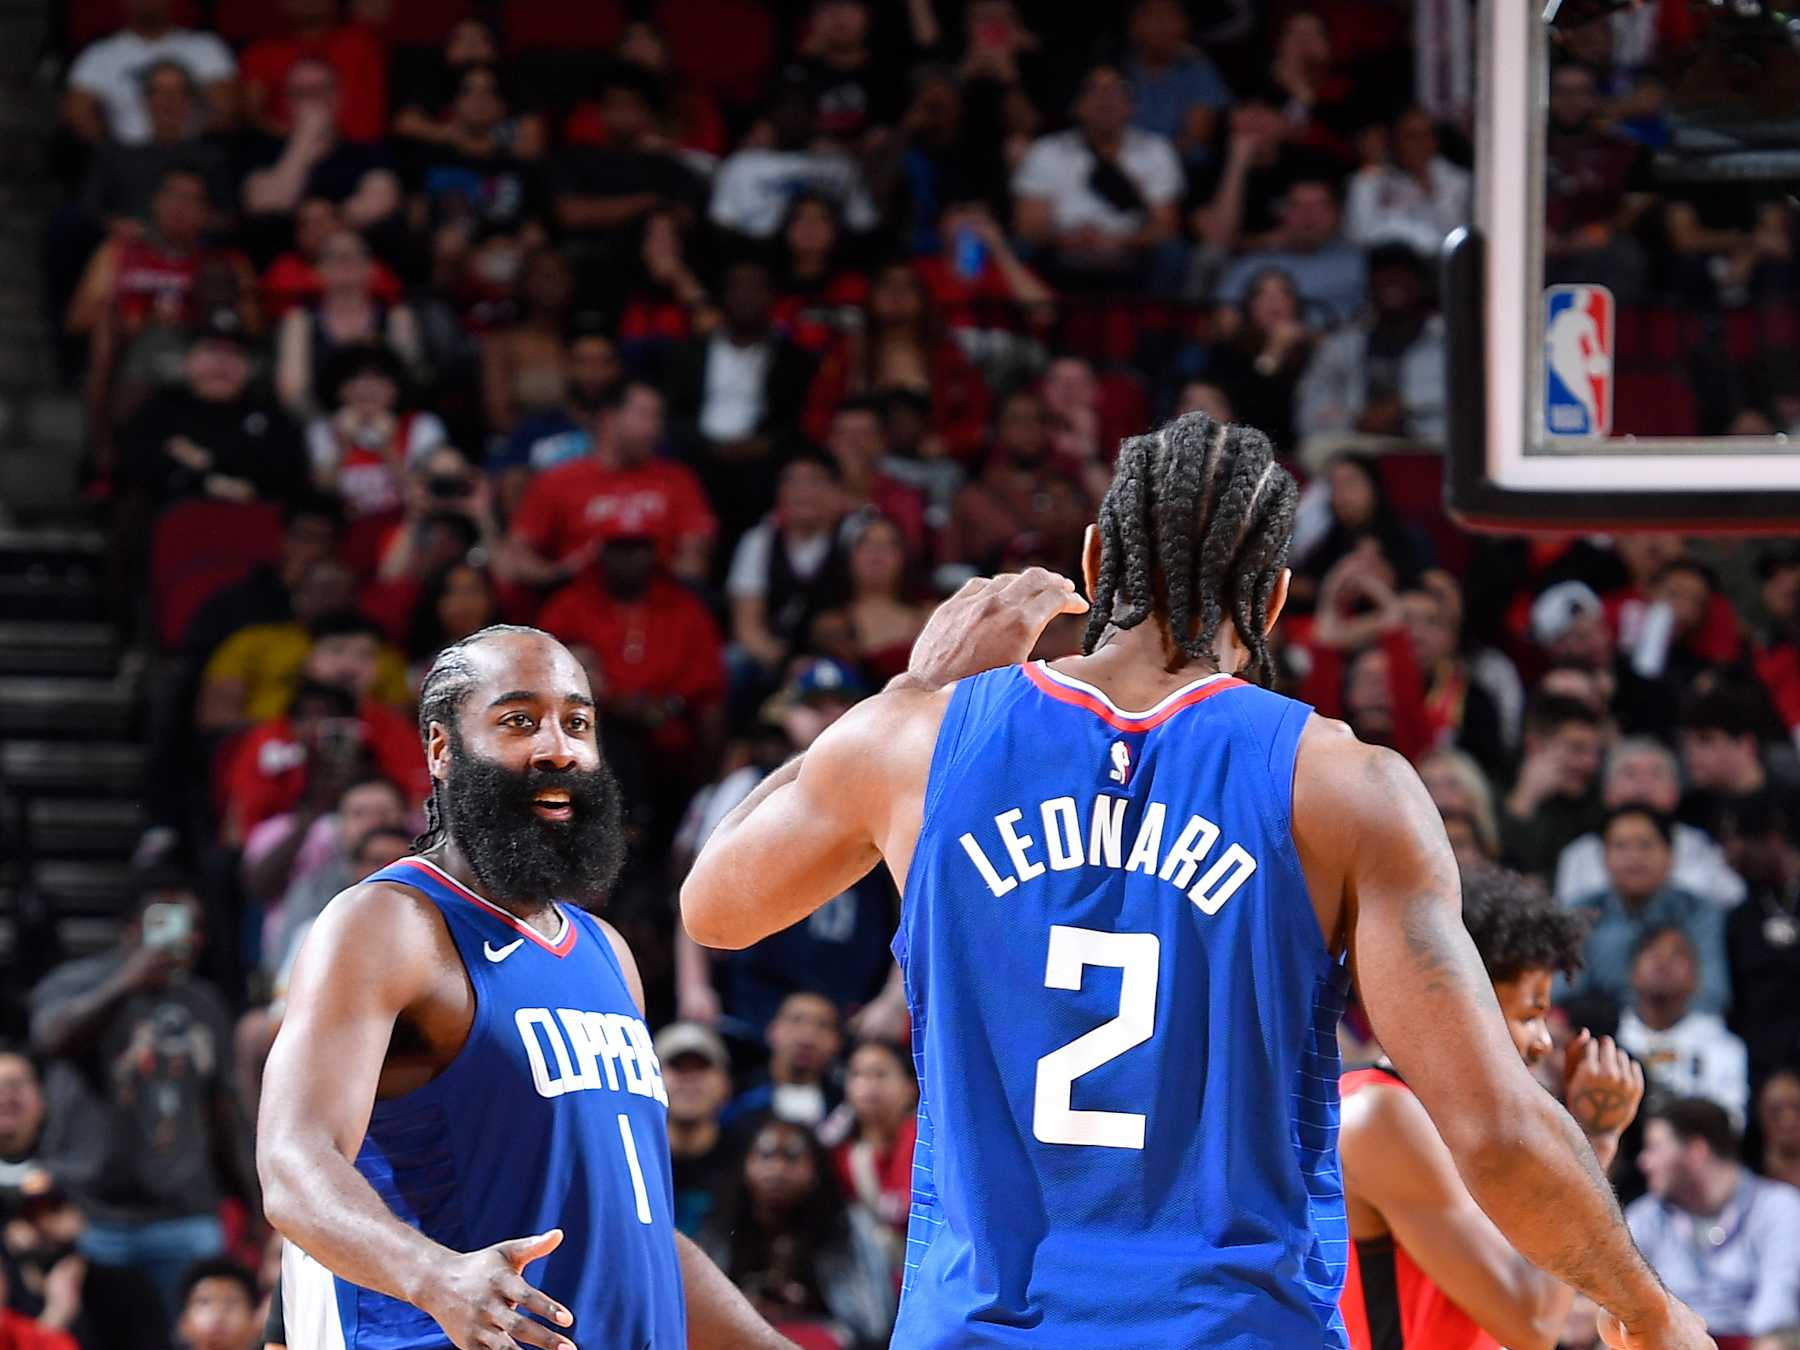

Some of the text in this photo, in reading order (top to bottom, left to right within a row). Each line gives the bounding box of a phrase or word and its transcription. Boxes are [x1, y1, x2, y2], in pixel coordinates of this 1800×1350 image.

[960, 795, 1257, 915] LEONARD
[515, 1008, 669, 1108] CLIPPERS
[1033, 925, 1160, 1150] 2
[617, 1114, 652, 1224] 1
